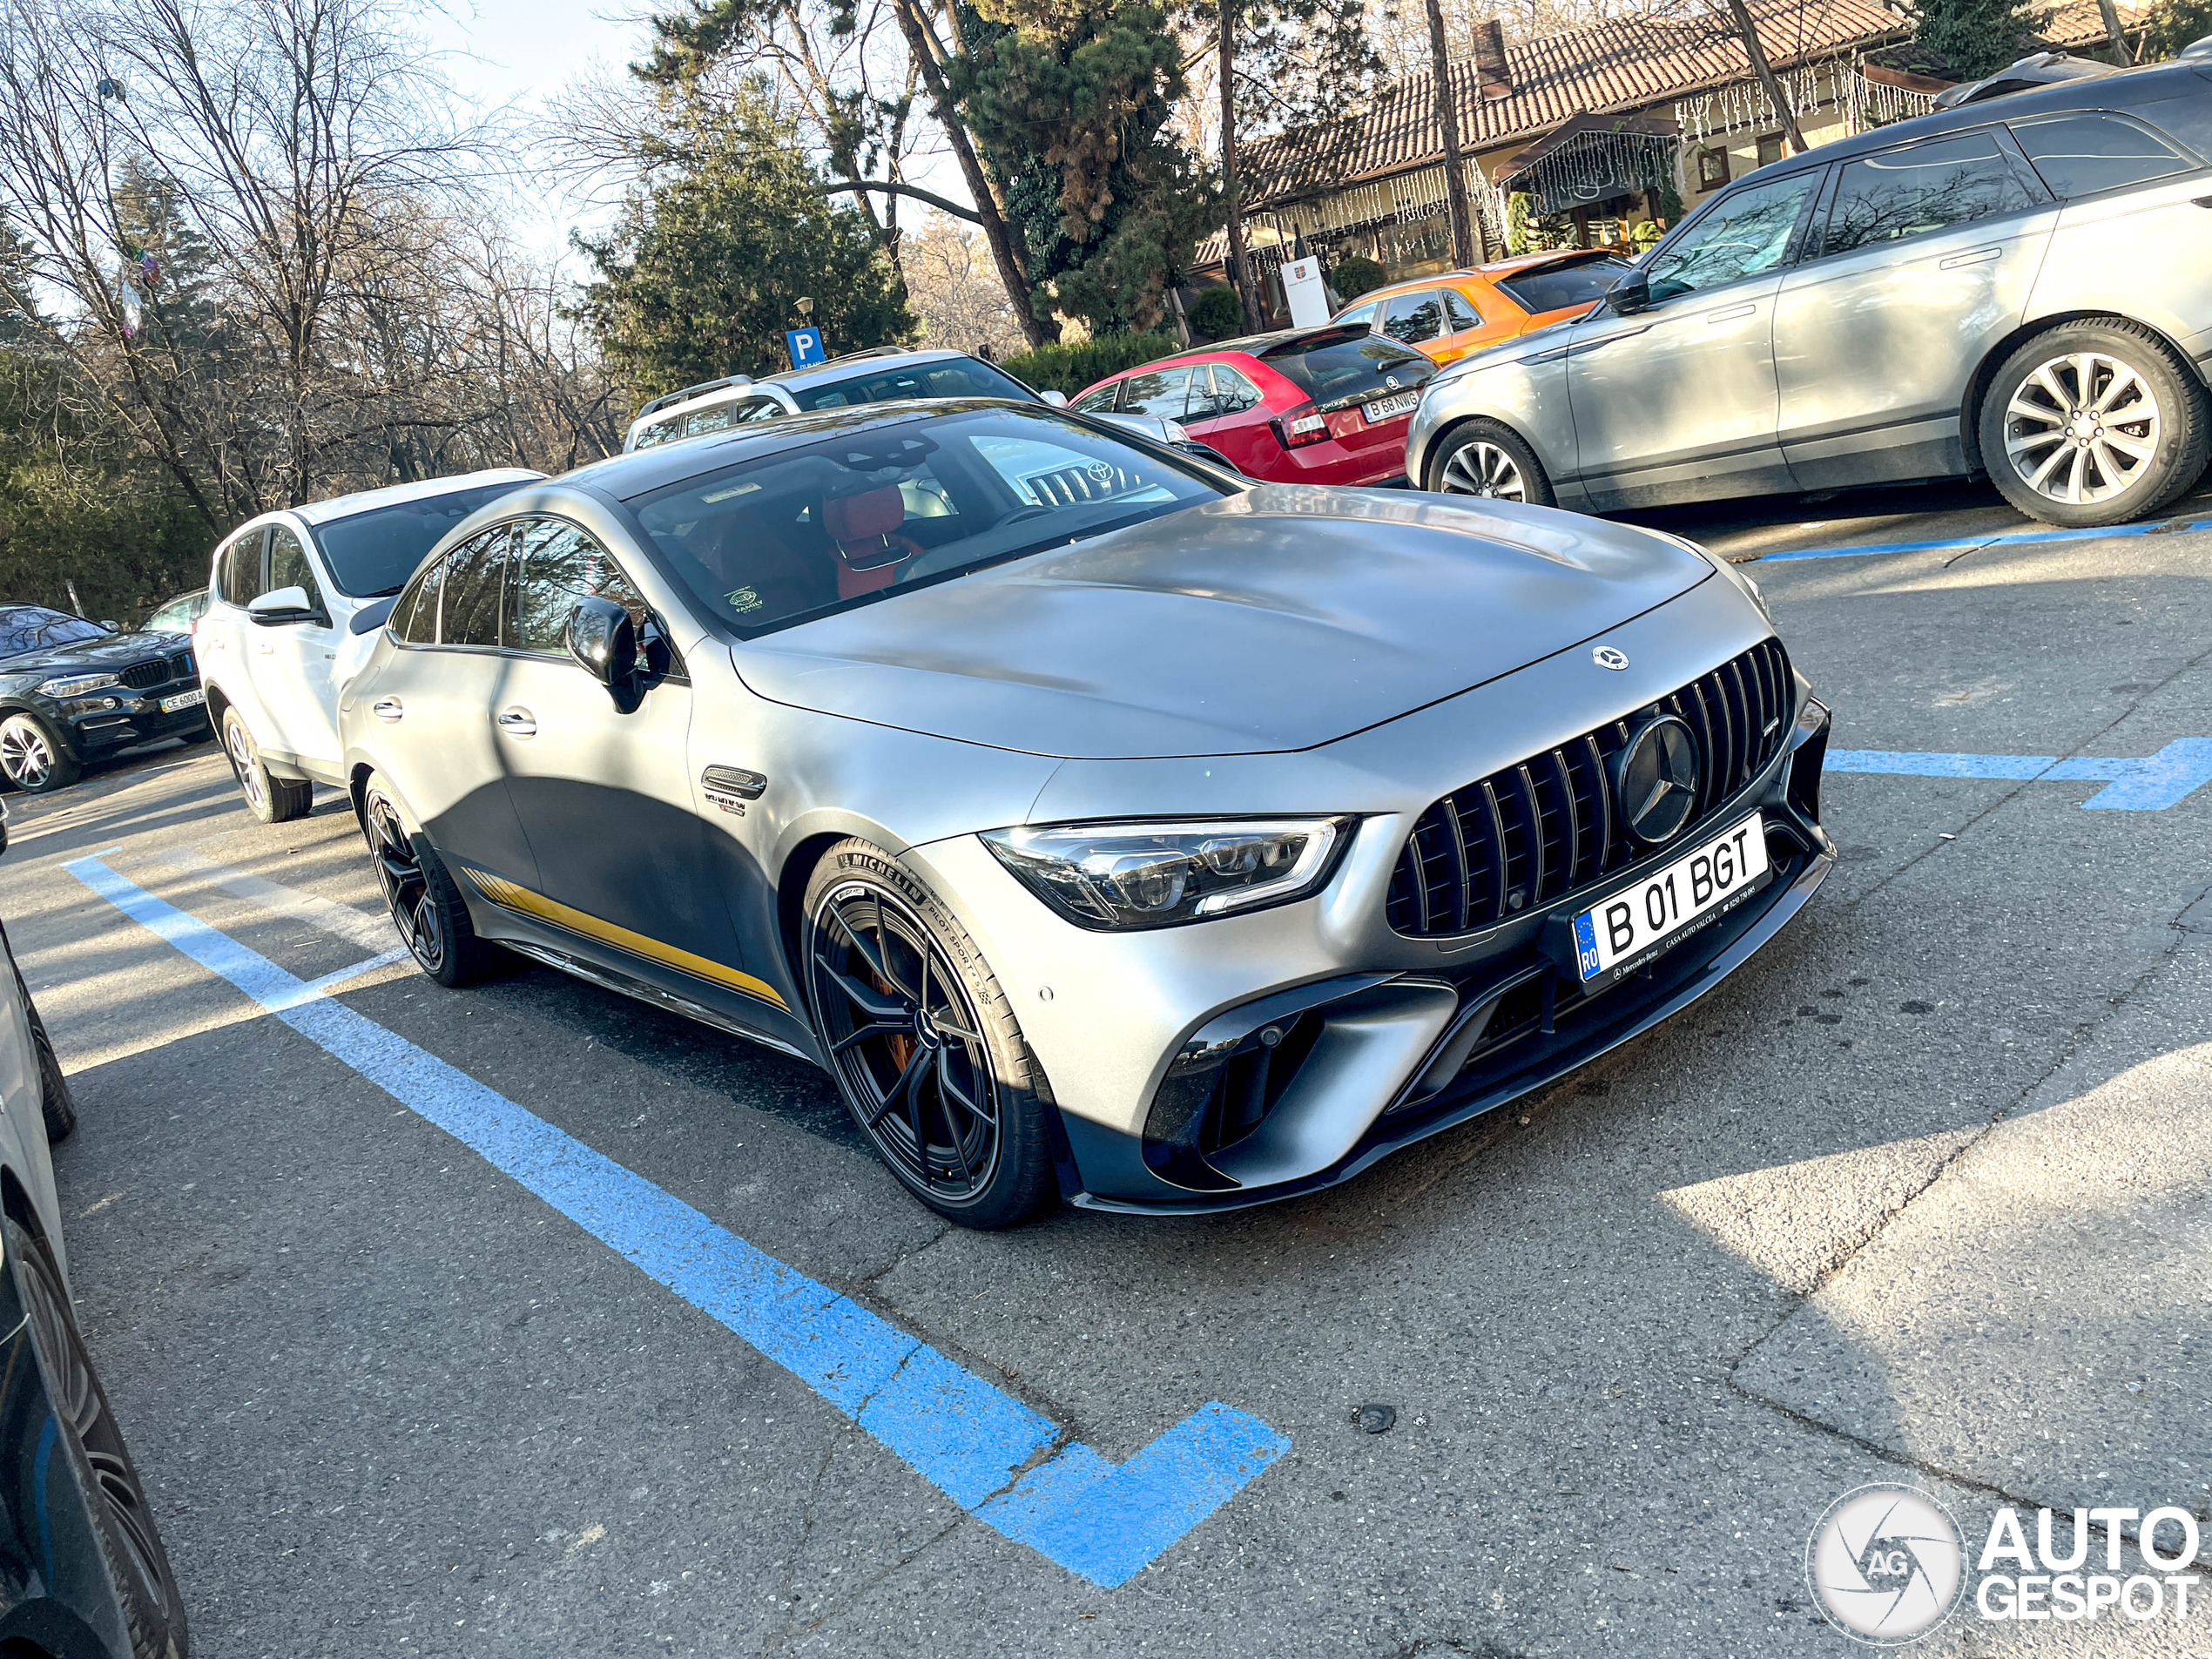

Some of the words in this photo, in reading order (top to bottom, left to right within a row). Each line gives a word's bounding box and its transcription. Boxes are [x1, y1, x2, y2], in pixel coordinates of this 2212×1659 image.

[795, 334, 813, 360] P
[1371, 403, 1380, 416] B
[1382, 399, 1395, 413] 68
[1394, 393, 1417, 409] NWG
[736, 600, 763, 613] FAMILY
[166, 698, 179, 708] CE
[179, 692, 197, 705] 6000
[199, 691, 206, 700] A
[852, 853, 921, 900] MICHELIN
[1606, 901, 1634, 955] B
[1646, 873, 1678, 931] 01
[1690, 828, 1747, 907] BGT
[928, 907, 950, 933] PILOT
[950, 935, 973, 971] SPORT
[1622, 949, 1659, 975] Mercedes-Benz
[1666, 935, 1682, 948] CASA
[1681, 925, 1696, 941] AUTO
[1696, 913, 1716, 931] VALCEA
[1581, 948, 1598, 973] RO
